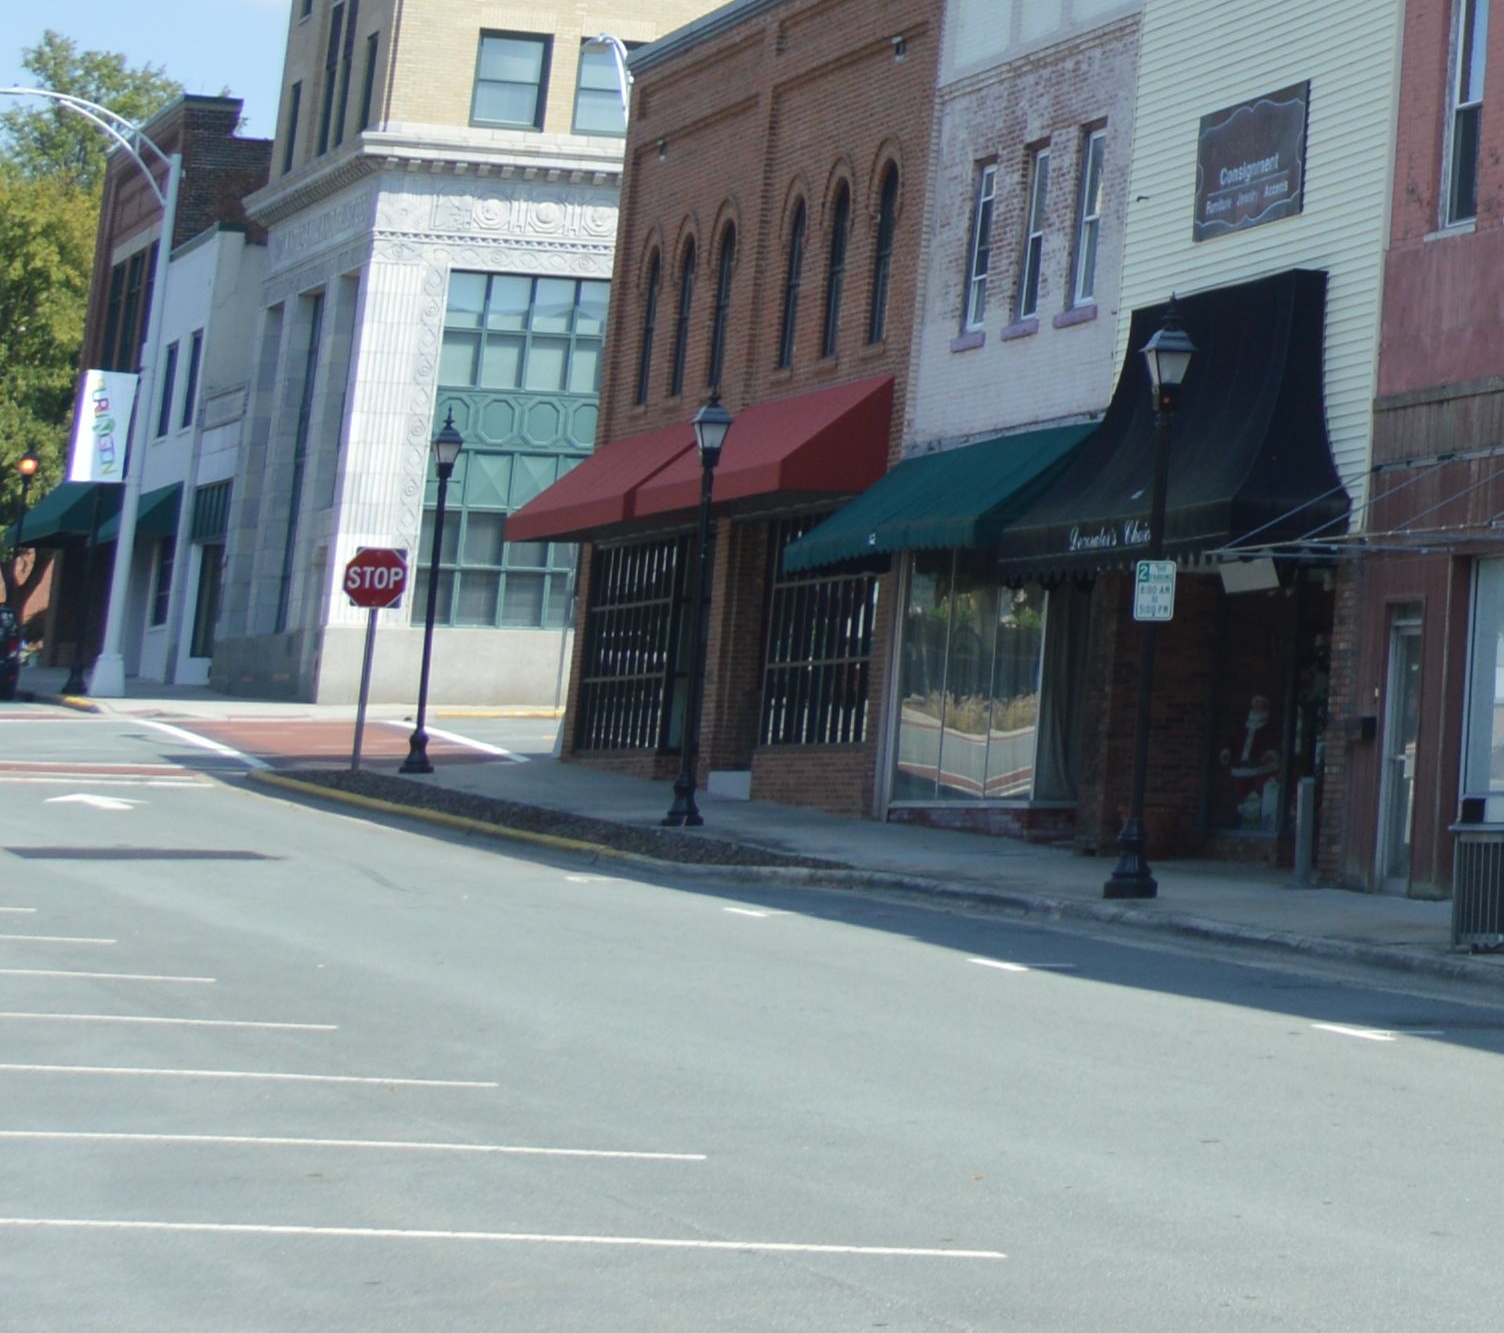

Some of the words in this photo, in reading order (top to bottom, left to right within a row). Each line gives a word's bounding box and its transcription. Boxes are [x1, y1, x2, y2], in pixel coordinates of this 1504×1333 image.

[1220, 152, 1279, 185] Consignment
[347, 566, 404, 589] STOP
[1140, 565, 1148, 580] 2
